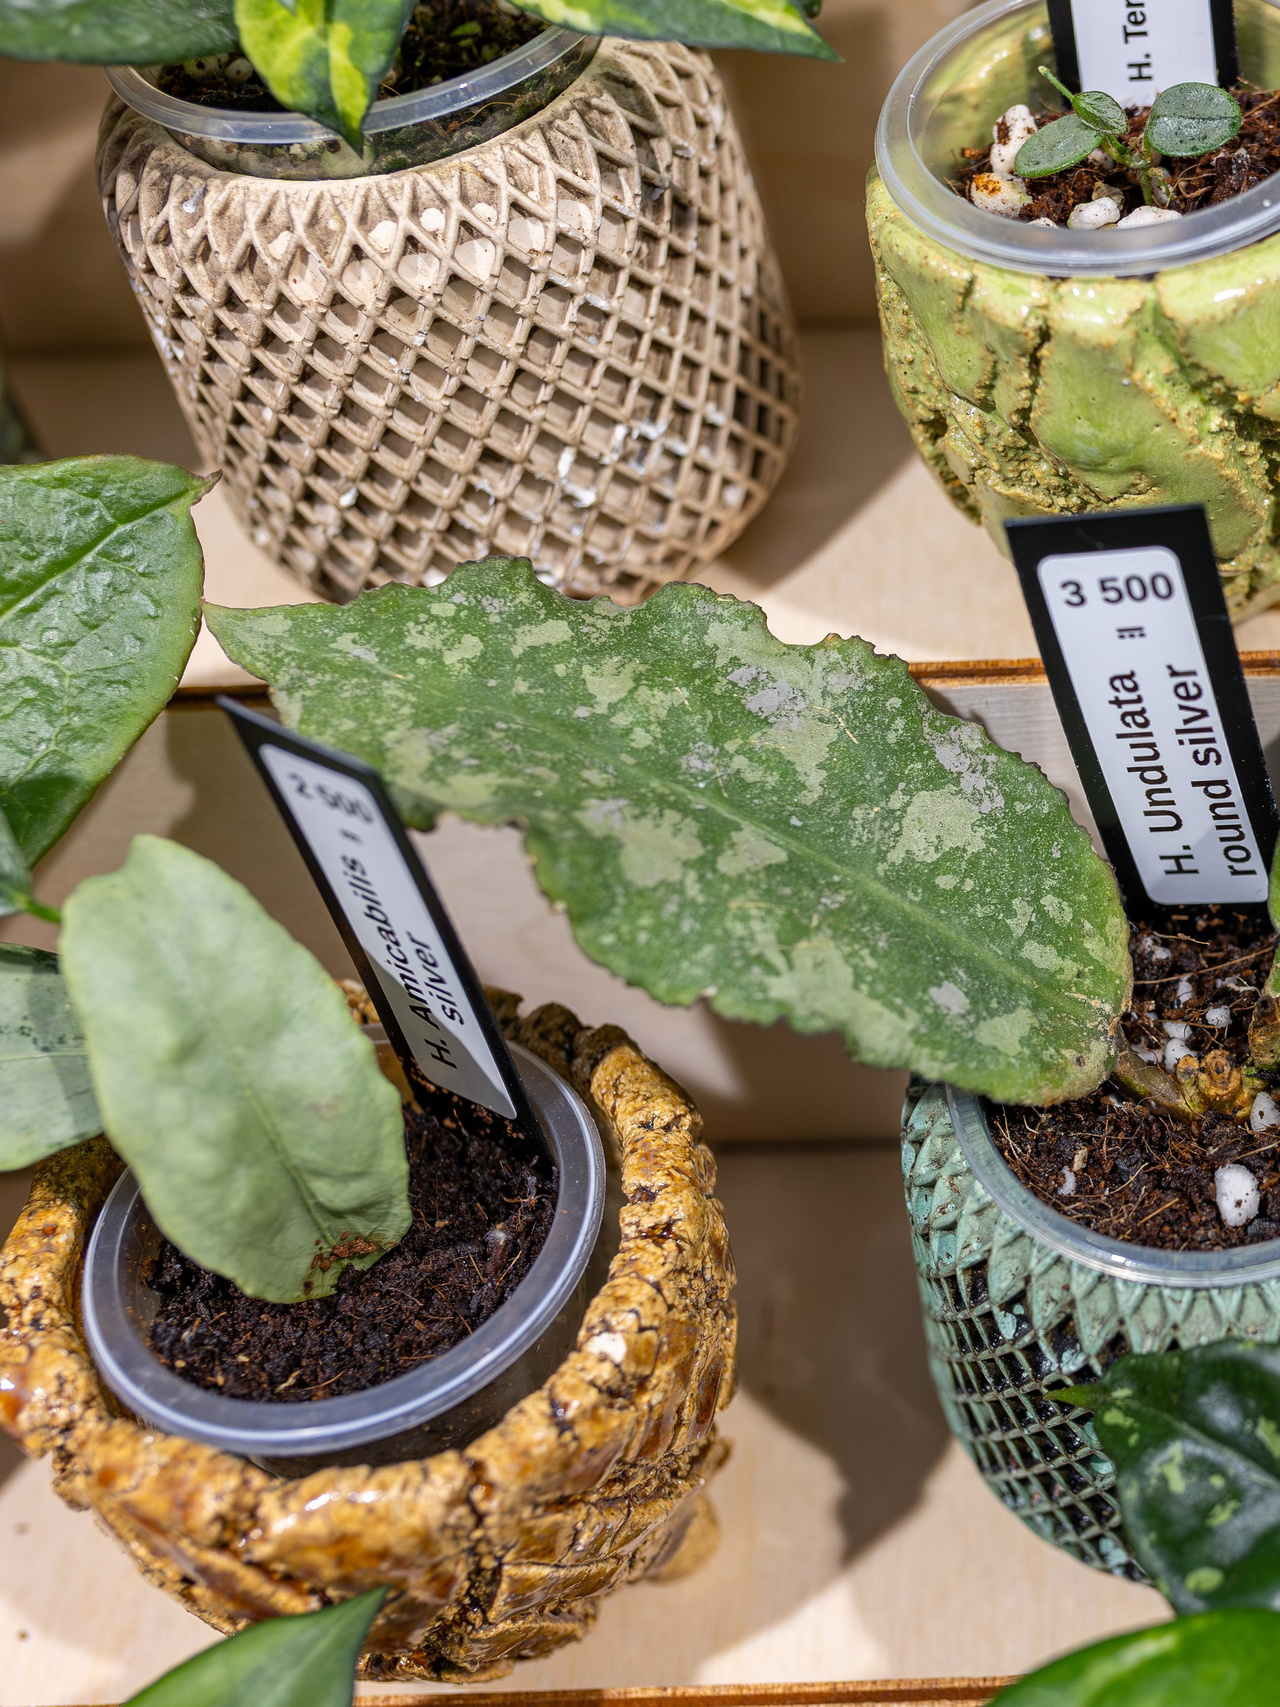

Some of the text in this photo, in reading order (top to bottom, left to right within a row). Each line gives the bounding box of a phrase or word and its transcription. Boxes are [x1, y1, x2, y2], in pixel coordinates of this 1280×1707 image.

[1127, 53, 1153, 82] H.
[1060, 572, 1175, 607] 3 500
[288, 772, 314, 799] 2
[1108, 670, 1200, 876] H. Undulata
[1165, 664, 1258, 877] round silver
[341, 854, 459, 1070] H. Amicabilis
[406, 930, 466, 1026] silver
